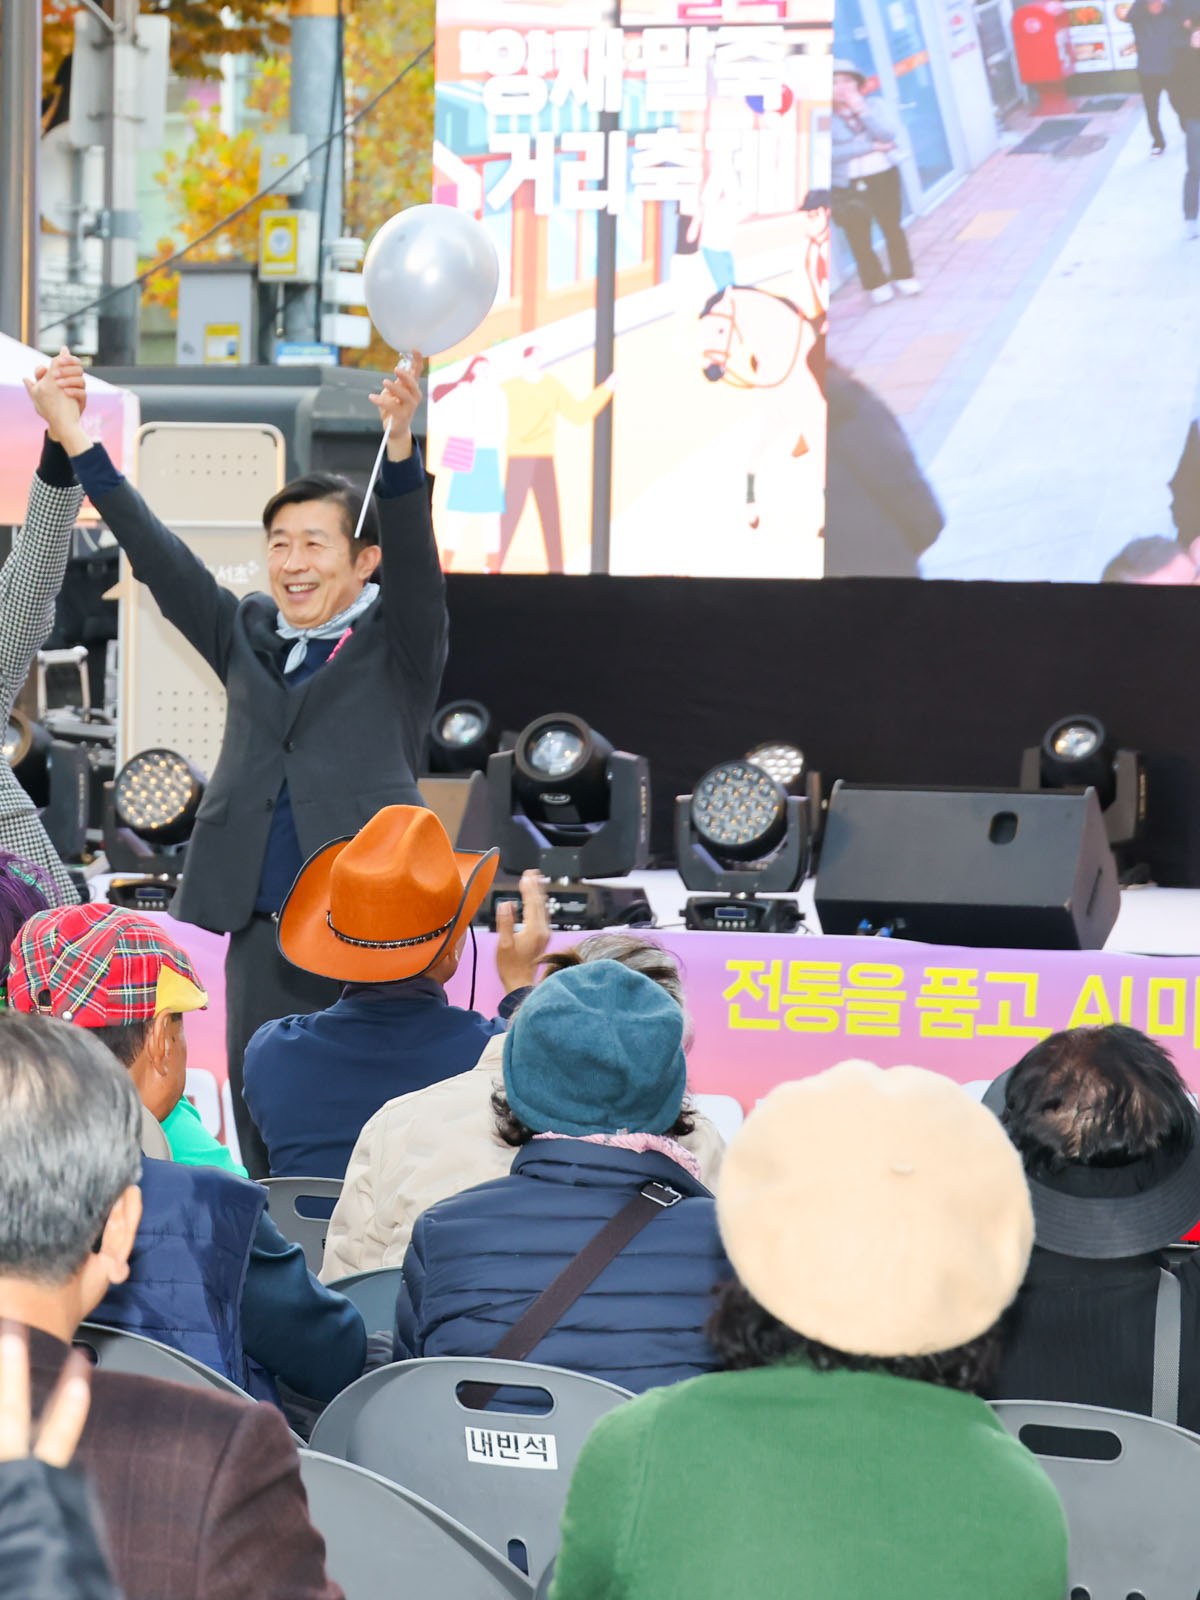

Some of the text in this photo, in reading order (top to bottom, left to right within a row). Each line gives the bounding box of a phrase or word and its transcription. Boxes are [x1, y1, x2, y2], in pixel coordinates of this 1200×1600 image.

[483, 26, 785, 115] 양재 말죽
[486, 129, 798, 216] 거리축제
[722, 959, 907, 1037] 전통을
[915, 967, 1053, 1044] 품고
[470, 1430, 548, 1462] 내빈석
